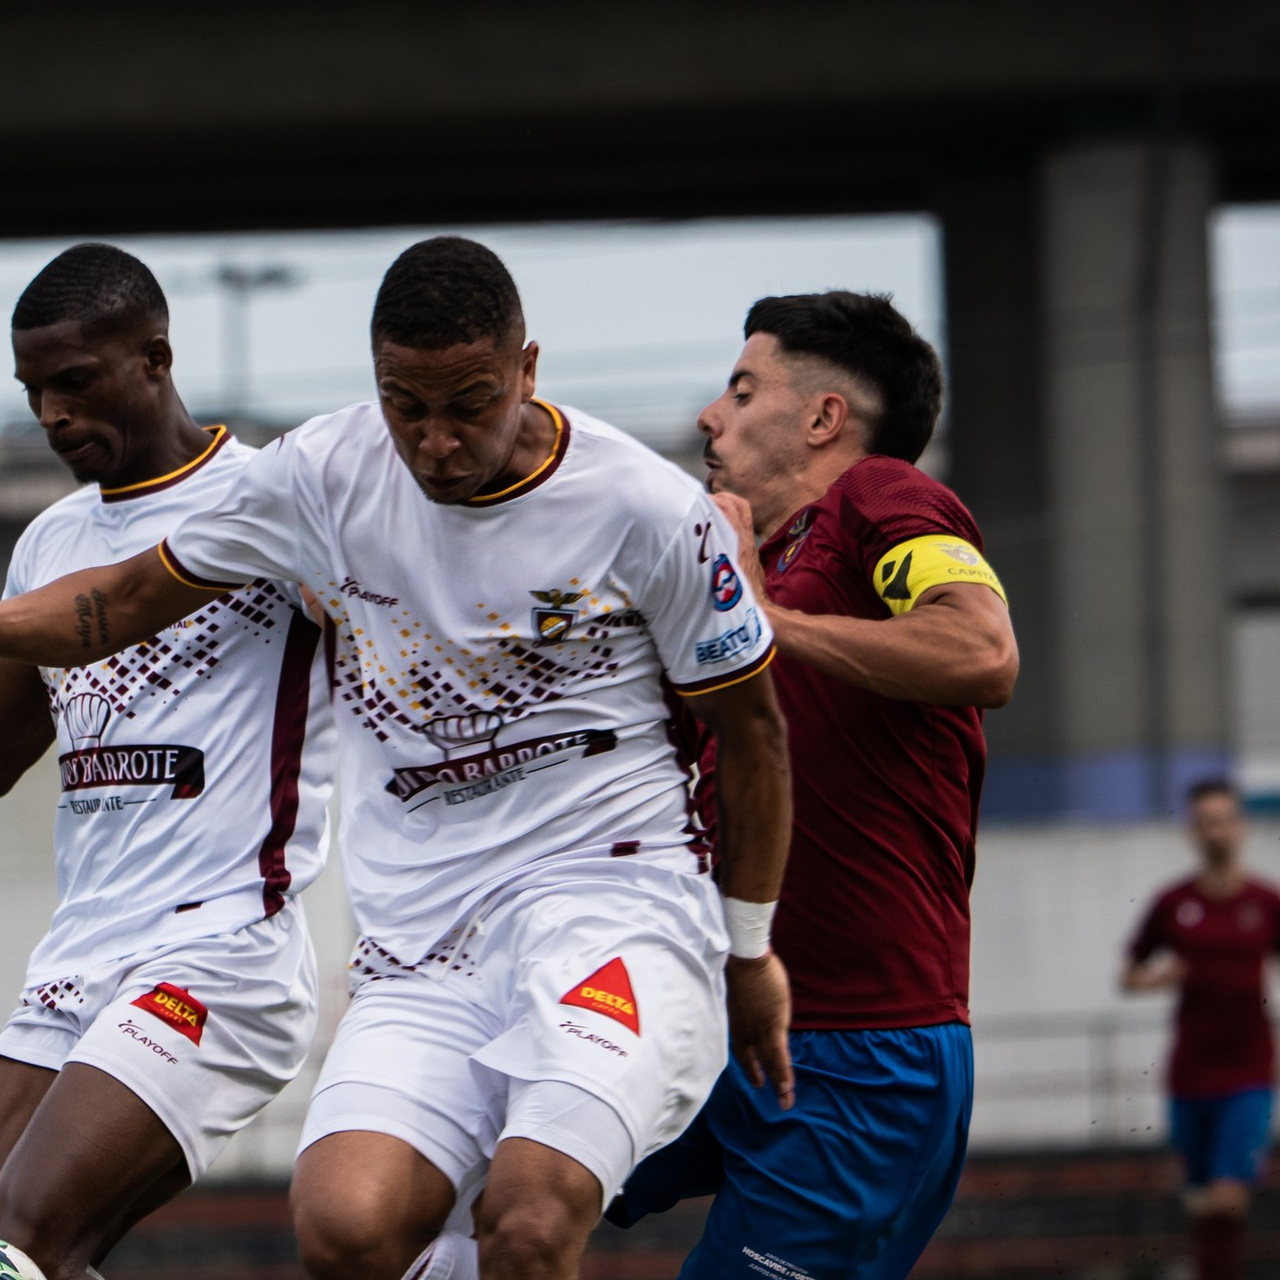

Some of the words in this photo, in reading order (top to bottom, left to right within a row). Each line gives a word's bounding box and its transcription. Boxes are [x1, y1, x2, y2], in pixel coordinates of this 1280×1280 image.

[80, 749, 179, 783] BARROTE
[154, 992, 198, 1027] DELTA
[580, 987, 634, 1015] DELTA
[122, 1027, 179, 1065] PLAYOFF
[566, 1027, 628, 1057] PLAYOFF
[742, 1246, 787, 1274] MOSCAVIDE
